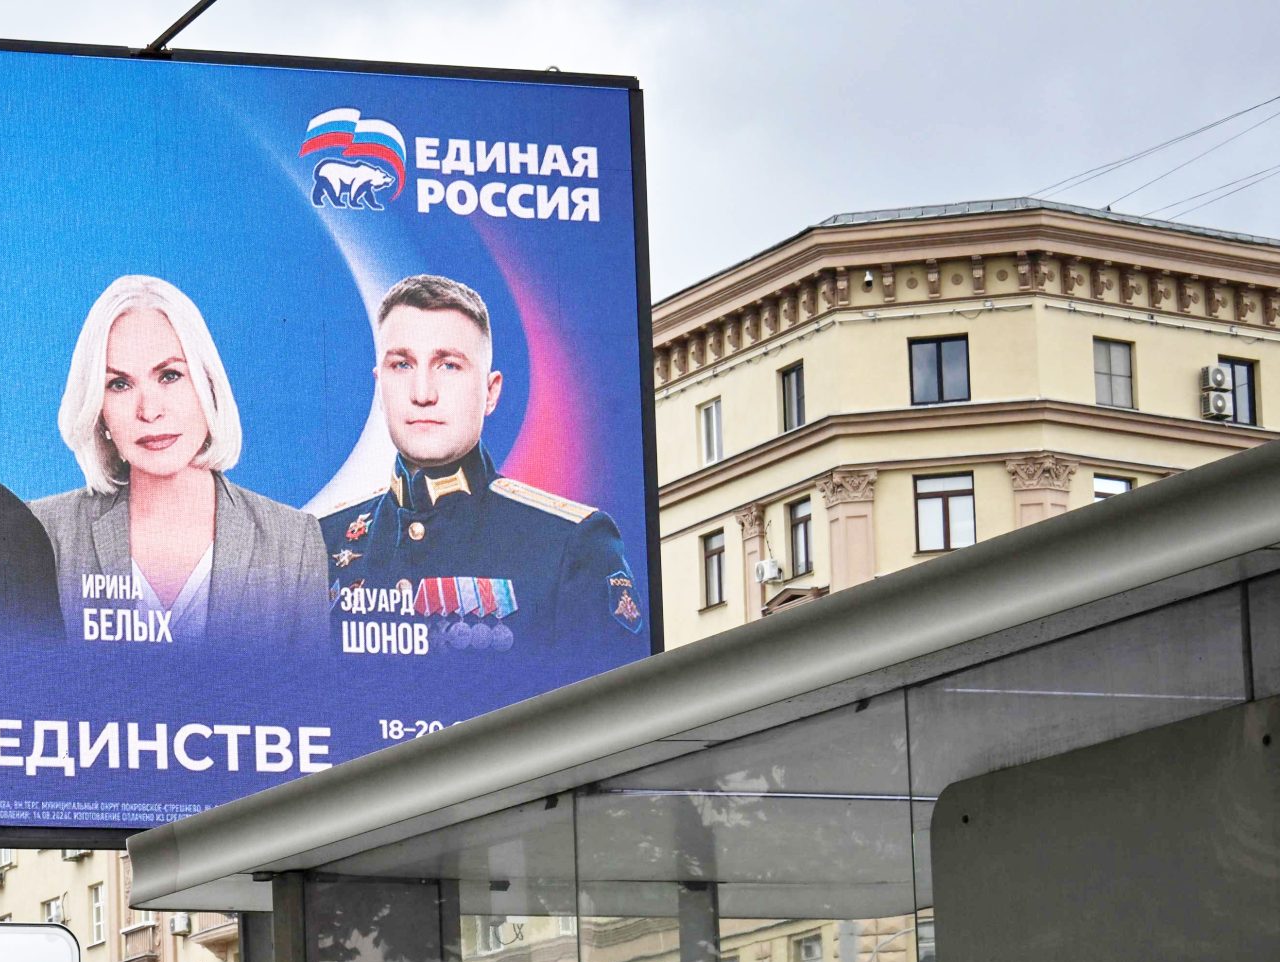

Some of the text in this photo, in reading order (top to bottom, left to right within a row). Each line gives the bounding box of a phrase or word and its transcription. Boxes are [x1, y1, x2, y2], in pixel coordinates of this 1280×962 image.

[415, 137, 599, 178] ЕДИНАЯ
[416, 178, 601, 222] РОССИЯ
[81, 573, 144, 601] ИРИНА
[340, 586, 415, 616] ЭДУАРД
[82, 607, 174, 644] БЕЛЫХ
[341, 620, 429, 656] ШОНОВ
